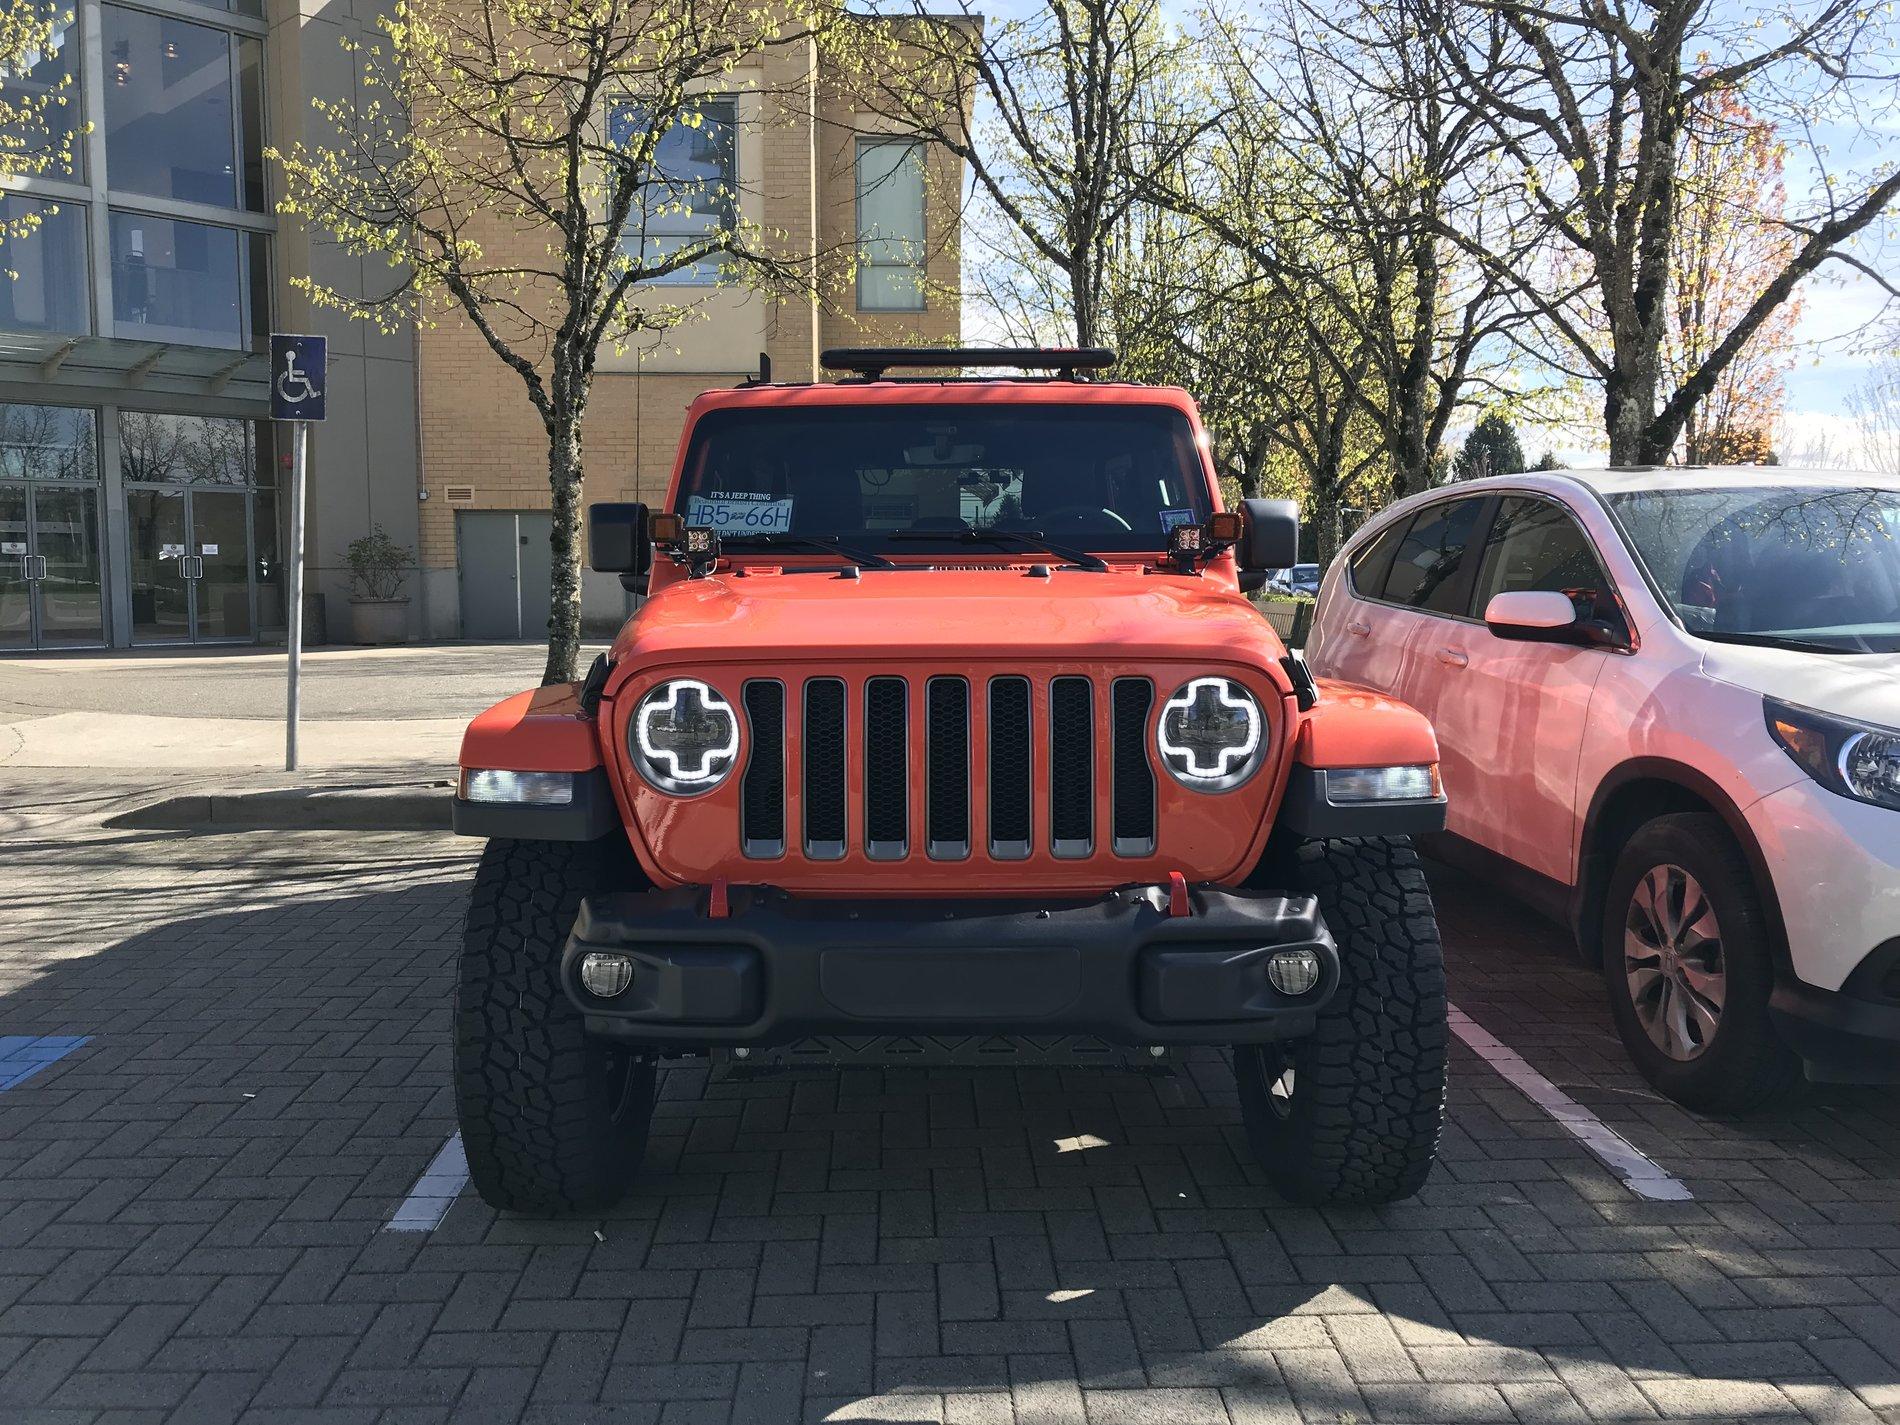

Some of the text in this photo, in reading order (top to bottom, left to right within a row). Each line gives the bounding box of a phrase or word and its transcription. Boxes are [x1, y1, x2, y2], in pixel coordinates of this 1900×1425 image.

[731, 492, 749, 500] JEEP
[749, 493, 771, 501] THING
[746, 506, 790, 527] 66H
